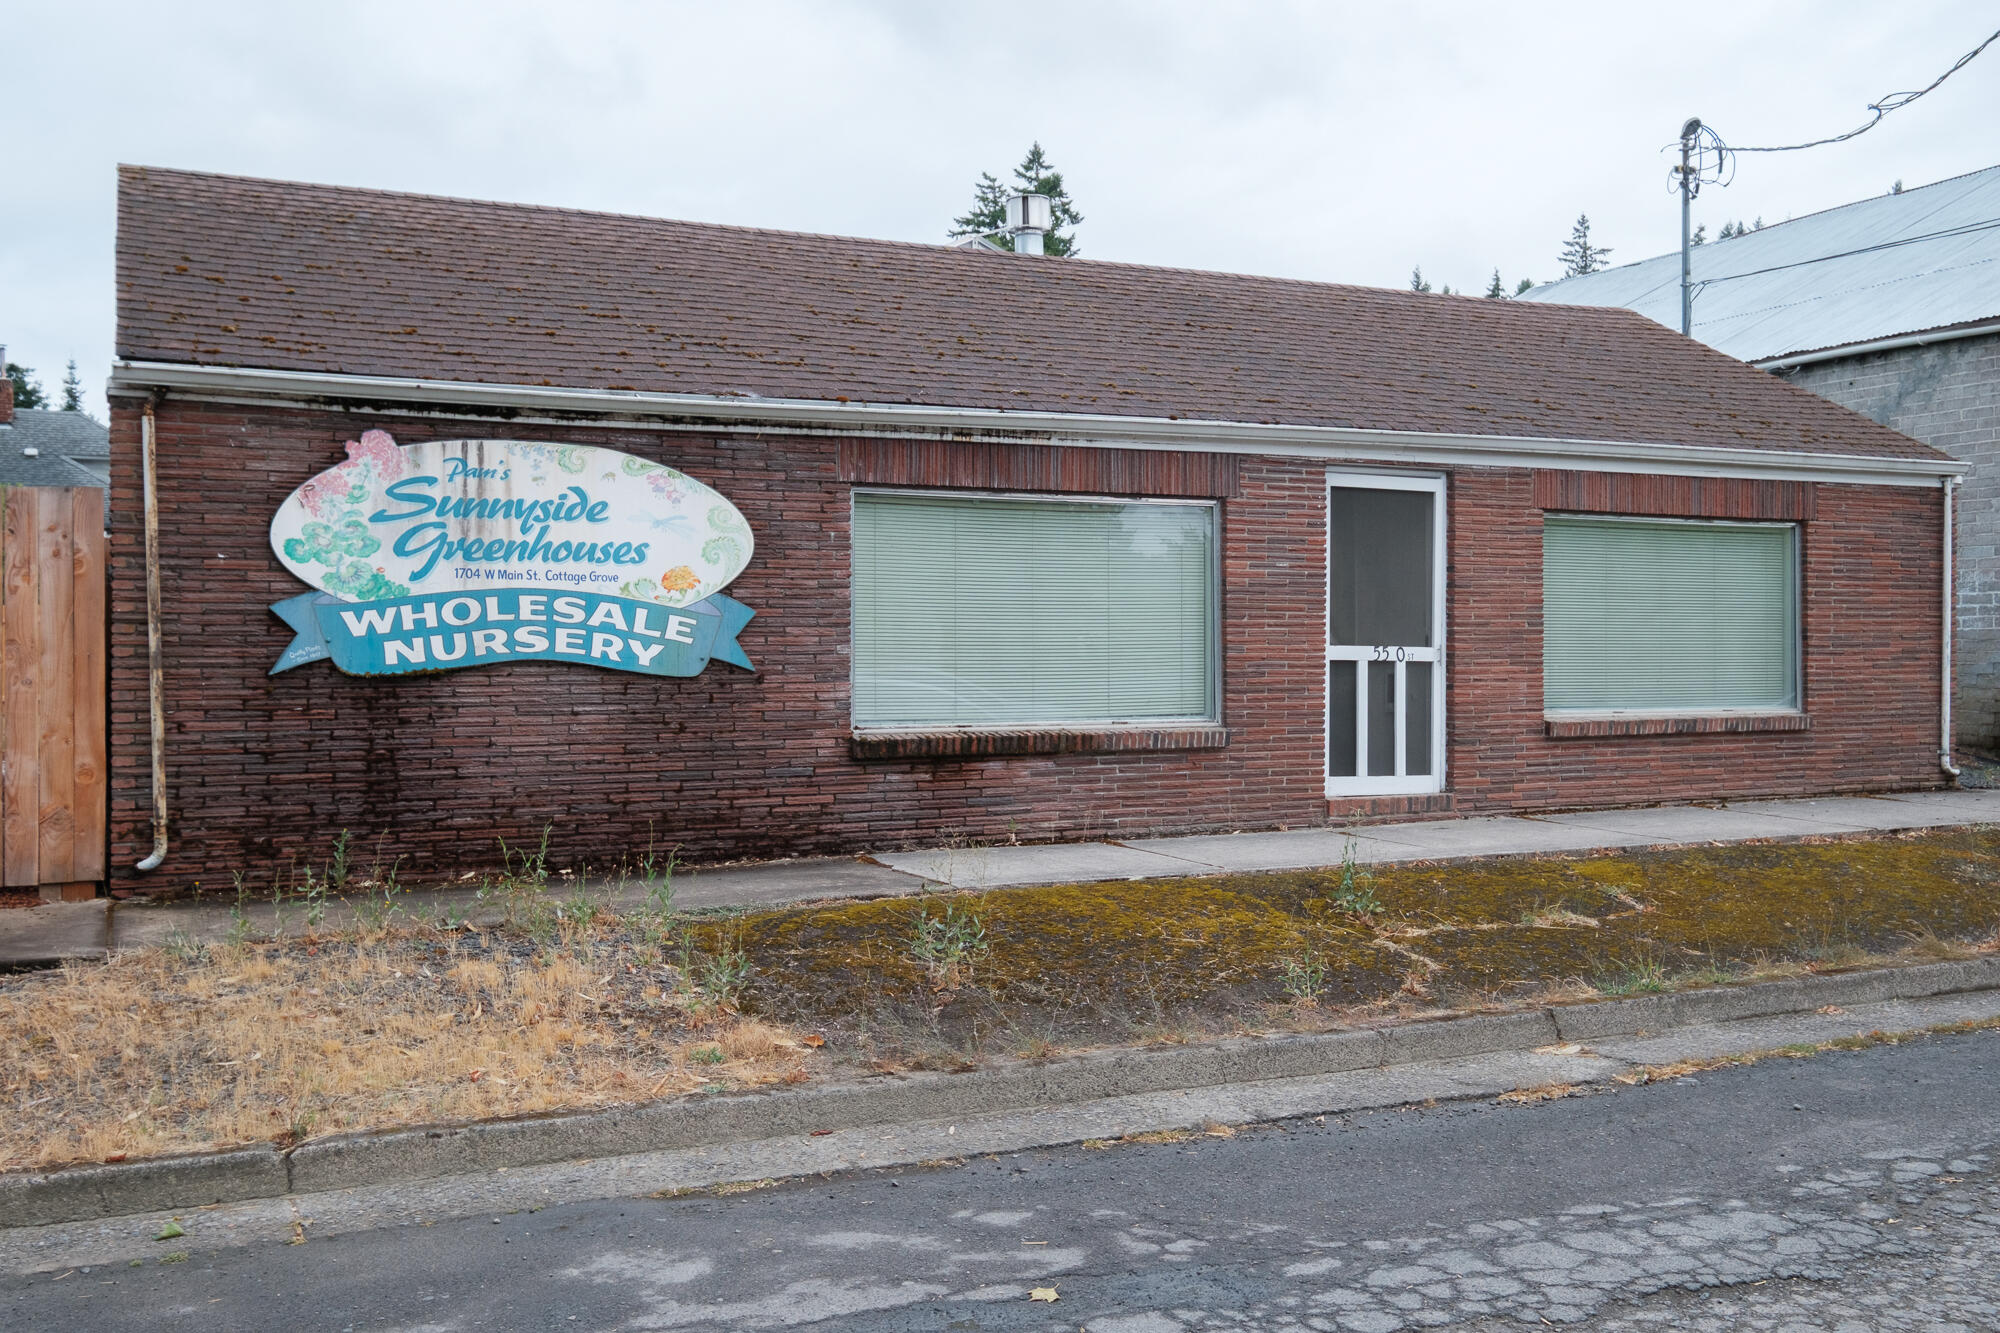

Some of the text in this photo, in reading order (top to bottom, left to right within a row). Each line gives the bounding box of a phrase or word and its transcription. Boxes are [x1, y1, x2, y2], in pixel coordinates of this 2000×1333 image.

[443, 457, 511, 483] Pam's
[368, 475, 609, 536] Sunnyside
[393, 521, 651, 582] Greenhouses
[454, 567, 619, 585] 1704 W Main St. Cottage Grove
[339, 595, 698, 645] WHOLESALE
[383, 625, 665, 667] NURSERY
